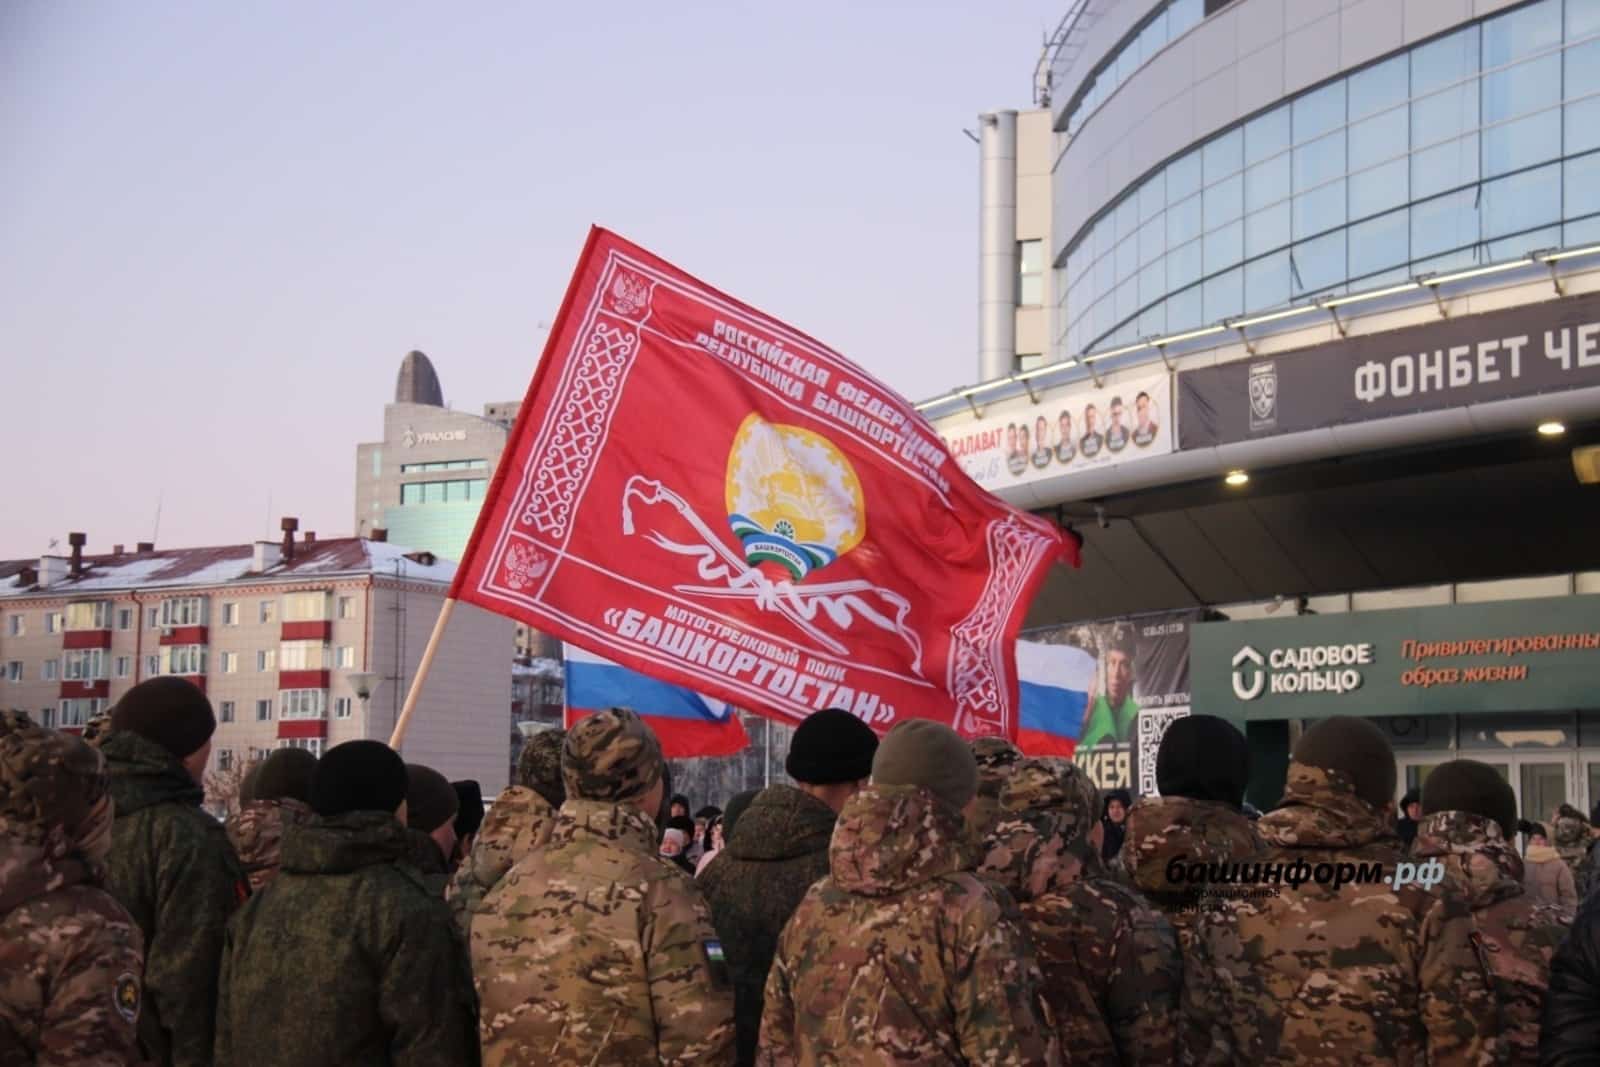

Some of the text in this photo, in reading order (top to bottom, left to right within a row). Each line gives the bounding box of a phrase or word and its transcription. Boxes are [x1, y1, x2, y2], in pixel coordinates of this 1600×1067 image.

[696, 332, 805, 401] РЕСПУБЛИКА
[713, 319, 830, 385] РОССИЙСКАЯ
[1354, 322, 1600, 402] ФОНБЕТ ЧЕ
[951, 427, 1003, 457] САЛАВАТ
[664, 604, 847, 682] МОТОСТРЕЛКОВЫЙ ПОЛК
[1270, 644, 1370, 669] САДОВОЕ
[1271, 669, 1360, 694] КОЛЬЦО
[1401, 664, 1527, 687] образ жизни
